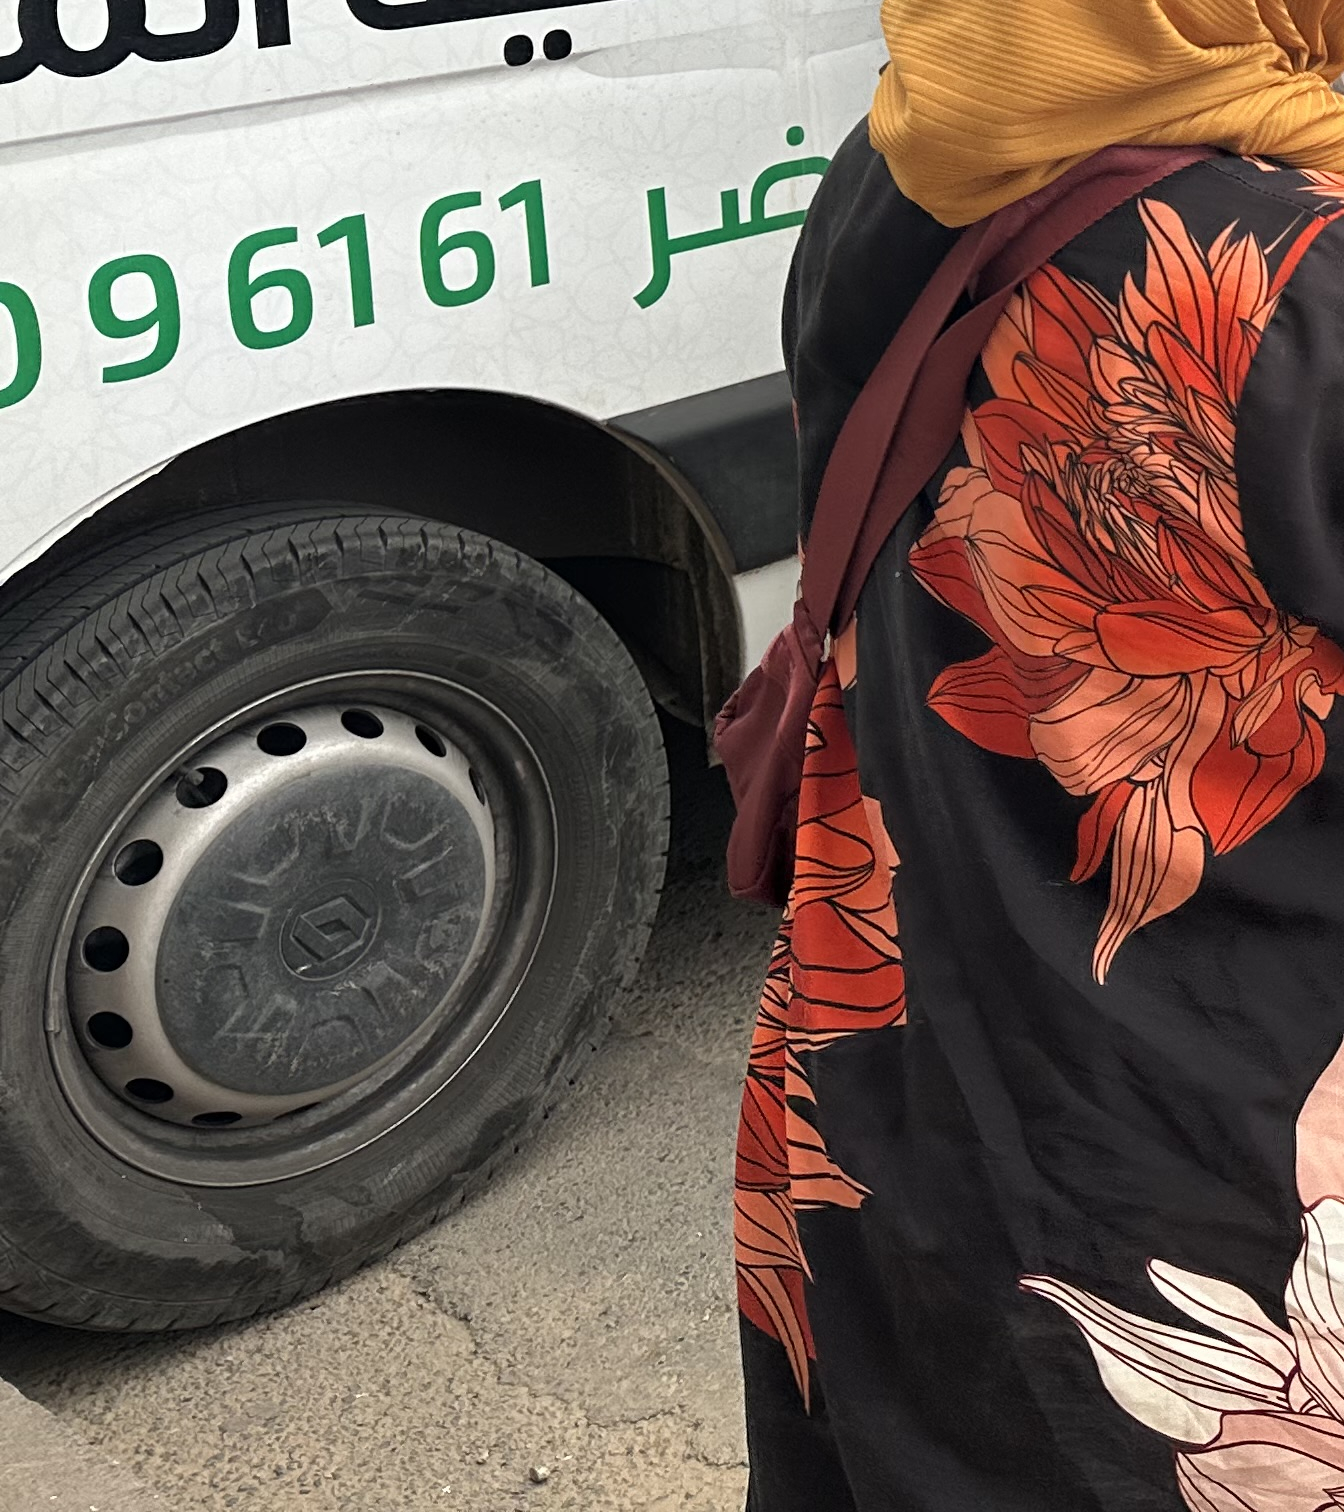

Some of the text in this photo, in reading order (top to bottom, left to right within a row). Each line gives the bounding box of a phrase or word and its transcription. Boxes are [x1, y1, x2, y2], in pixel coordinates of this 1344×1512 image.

[87, 253, 182, 384] 9
[226, 212, 376, 352] 61
[417, 178, 553, 309] 61
[631, 125, 831, 311] ضر
